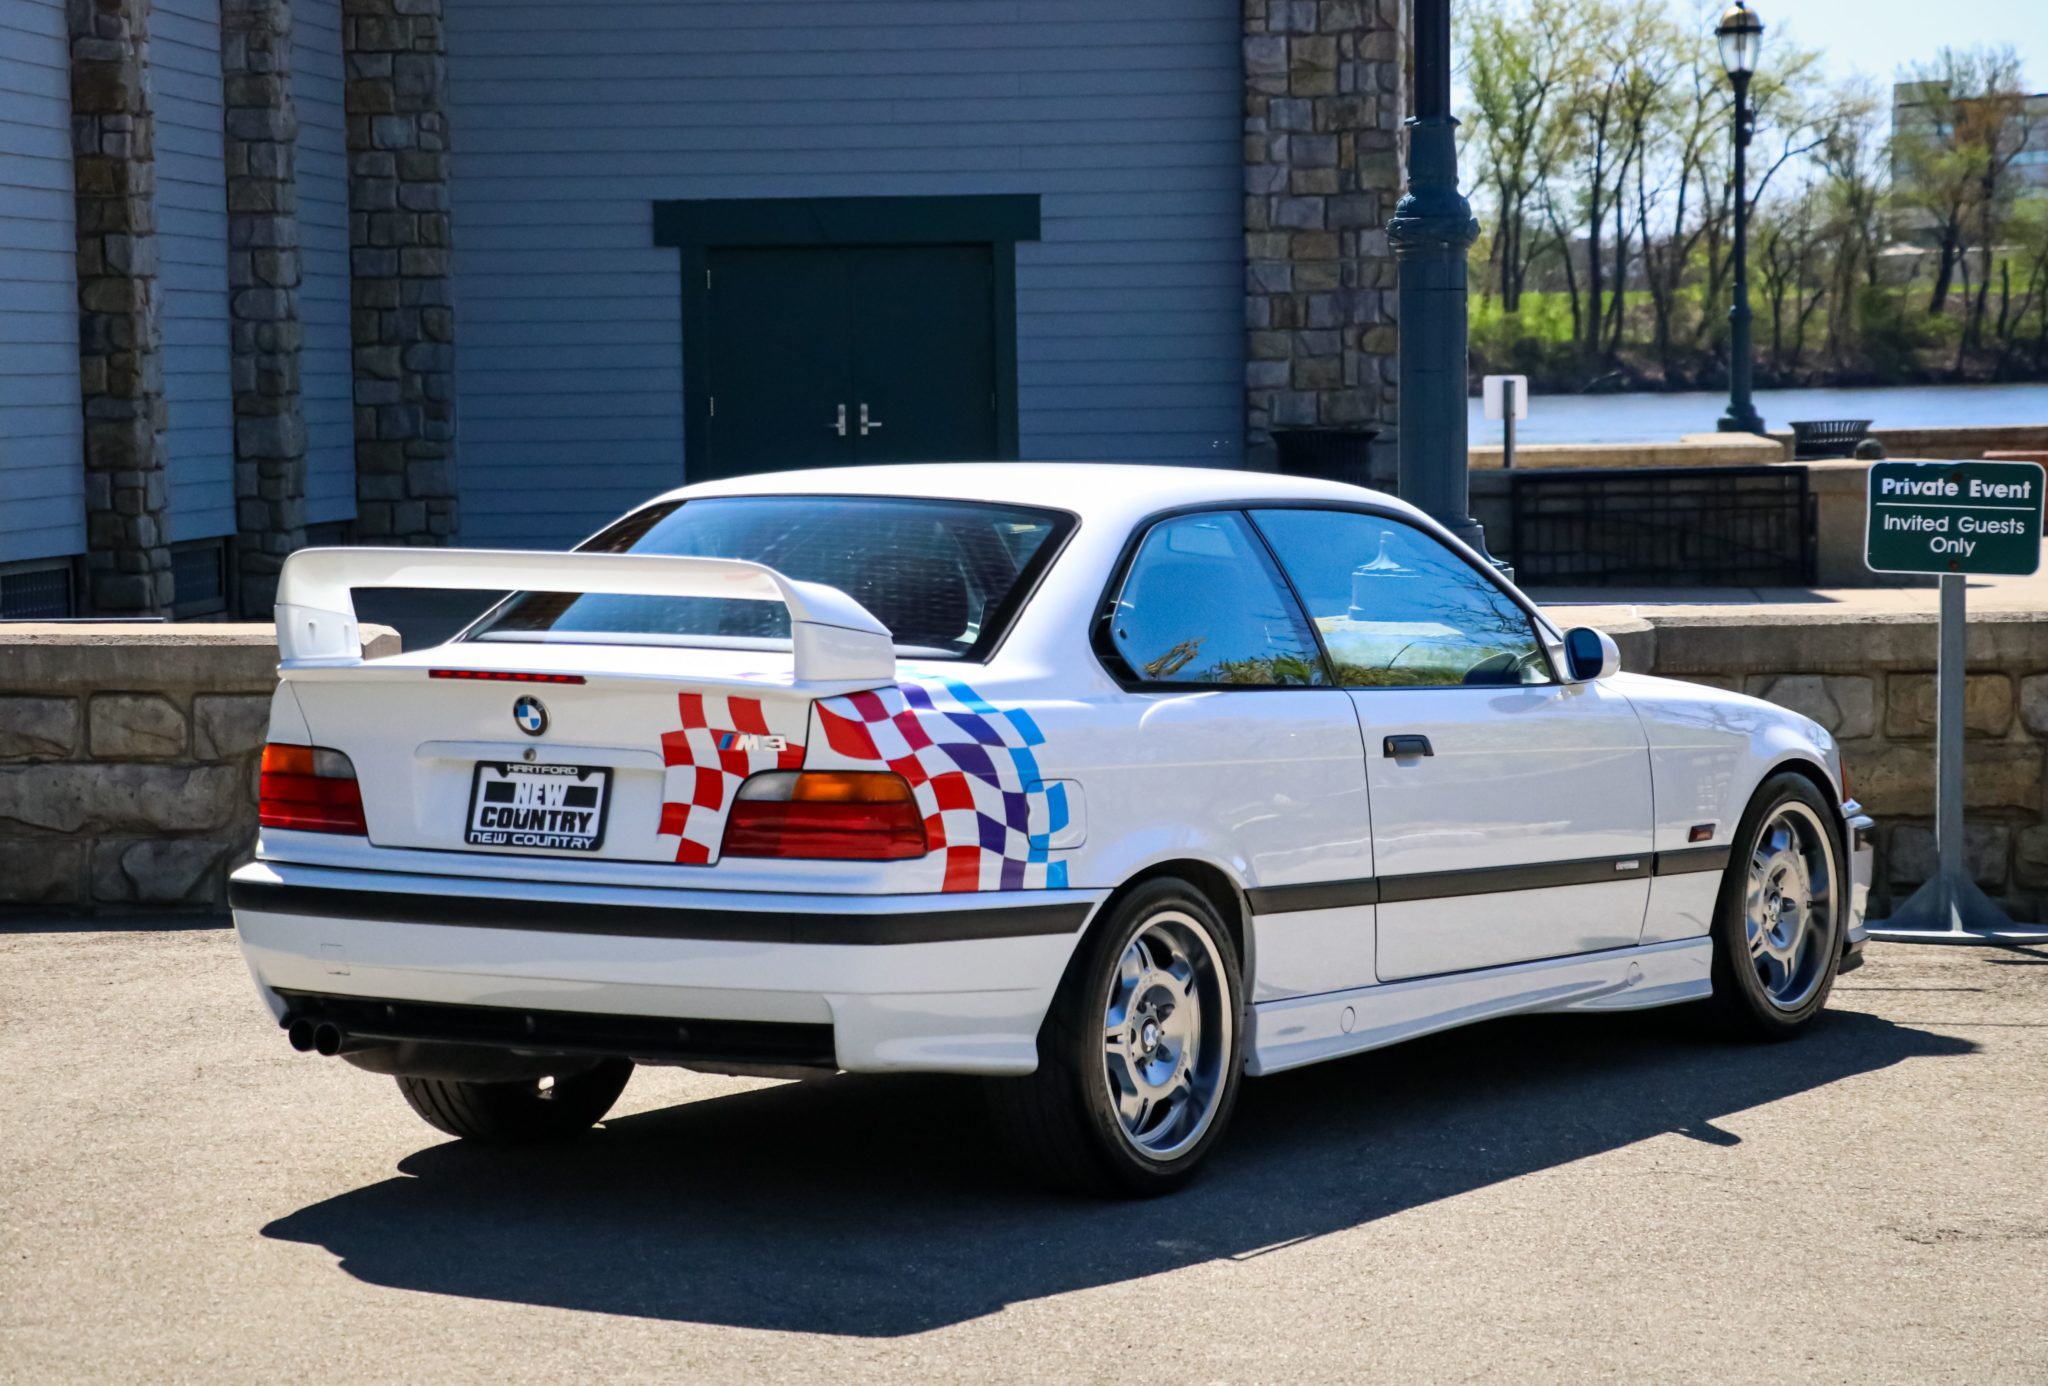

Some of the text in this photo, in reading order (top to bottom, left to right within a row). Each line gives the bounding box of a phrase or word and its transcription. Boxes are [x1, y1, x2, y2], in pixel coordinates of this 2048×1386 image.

[1881, 478, 2031, 499] Private Event
[1884, 514, 2025, 534] Invited Guests
[1930, 536, 1976, 557] Only
[735, 733, 787, 751] M3
[507, 764, 578, 775] HARTFORD
[515, 782, 568, 806] NEW
[480, 806, 593, 833] COUNTRY
[469, 832, 595, 849] NEW COUNTRY
